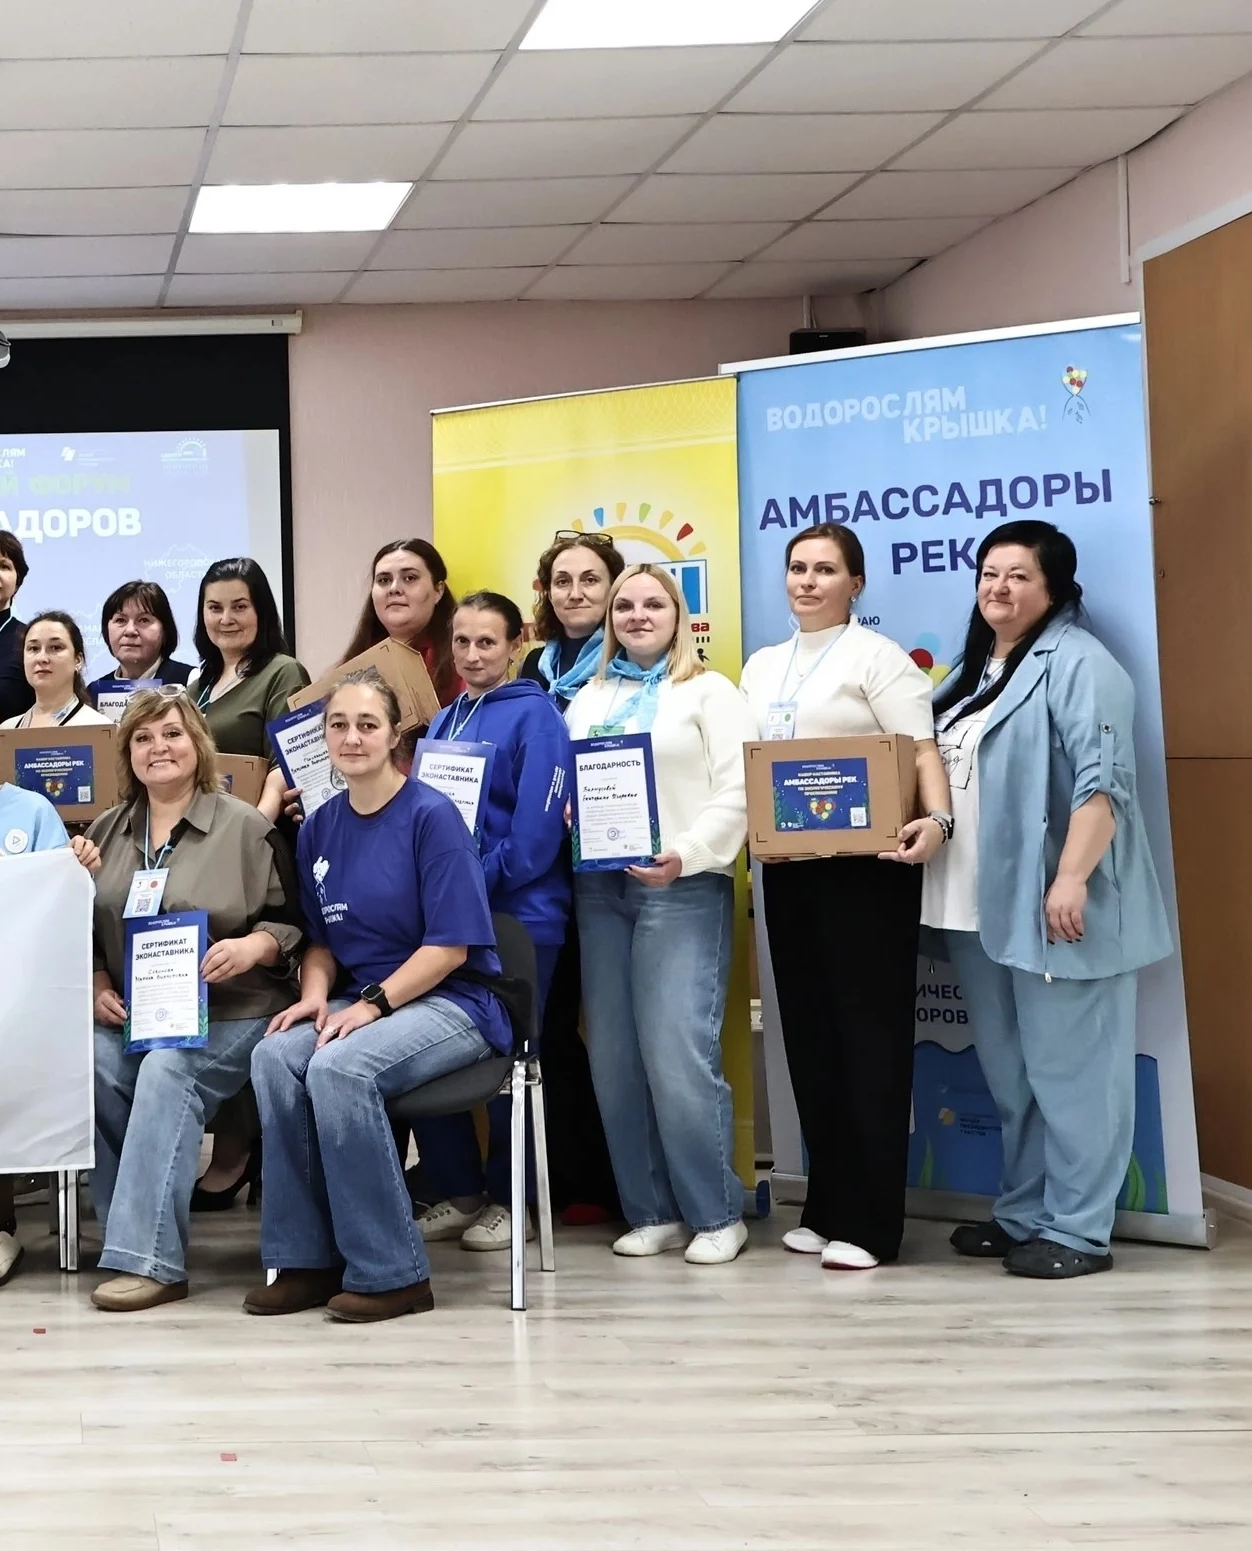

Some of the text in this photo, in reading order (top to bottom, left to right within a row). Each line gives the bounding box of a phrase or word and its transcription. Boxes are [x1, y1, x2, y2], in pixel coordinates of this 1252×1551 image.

[766, 386, 966, 431] ВОДОРОСЛЯМ
[903, 404, 1047, 443] КРЫШКА!
[759, 469, 1112, 530] АМБАССАДОРЫ
[892, 537, 978, 575] РЕК
[24, 761, 71, 769] АМБАССАДОРЫ
[429, 763, 474, 773] СЕРТИФИКАТ
[579, 760, 641, 771] БЛАГОДАРНОСТЬ
[421, 772, 479, 784] ЭКОНАСТАВНИКА
[784, 777, 841, 786] АМБАССАДОРЫ
[141, 938, 187, 950] СЕРТИФИКАТ
[135, 947, 195, 961] ЭКОНАСТАВНИКА
[916, 1007, 968, 1024] ОРОВ
